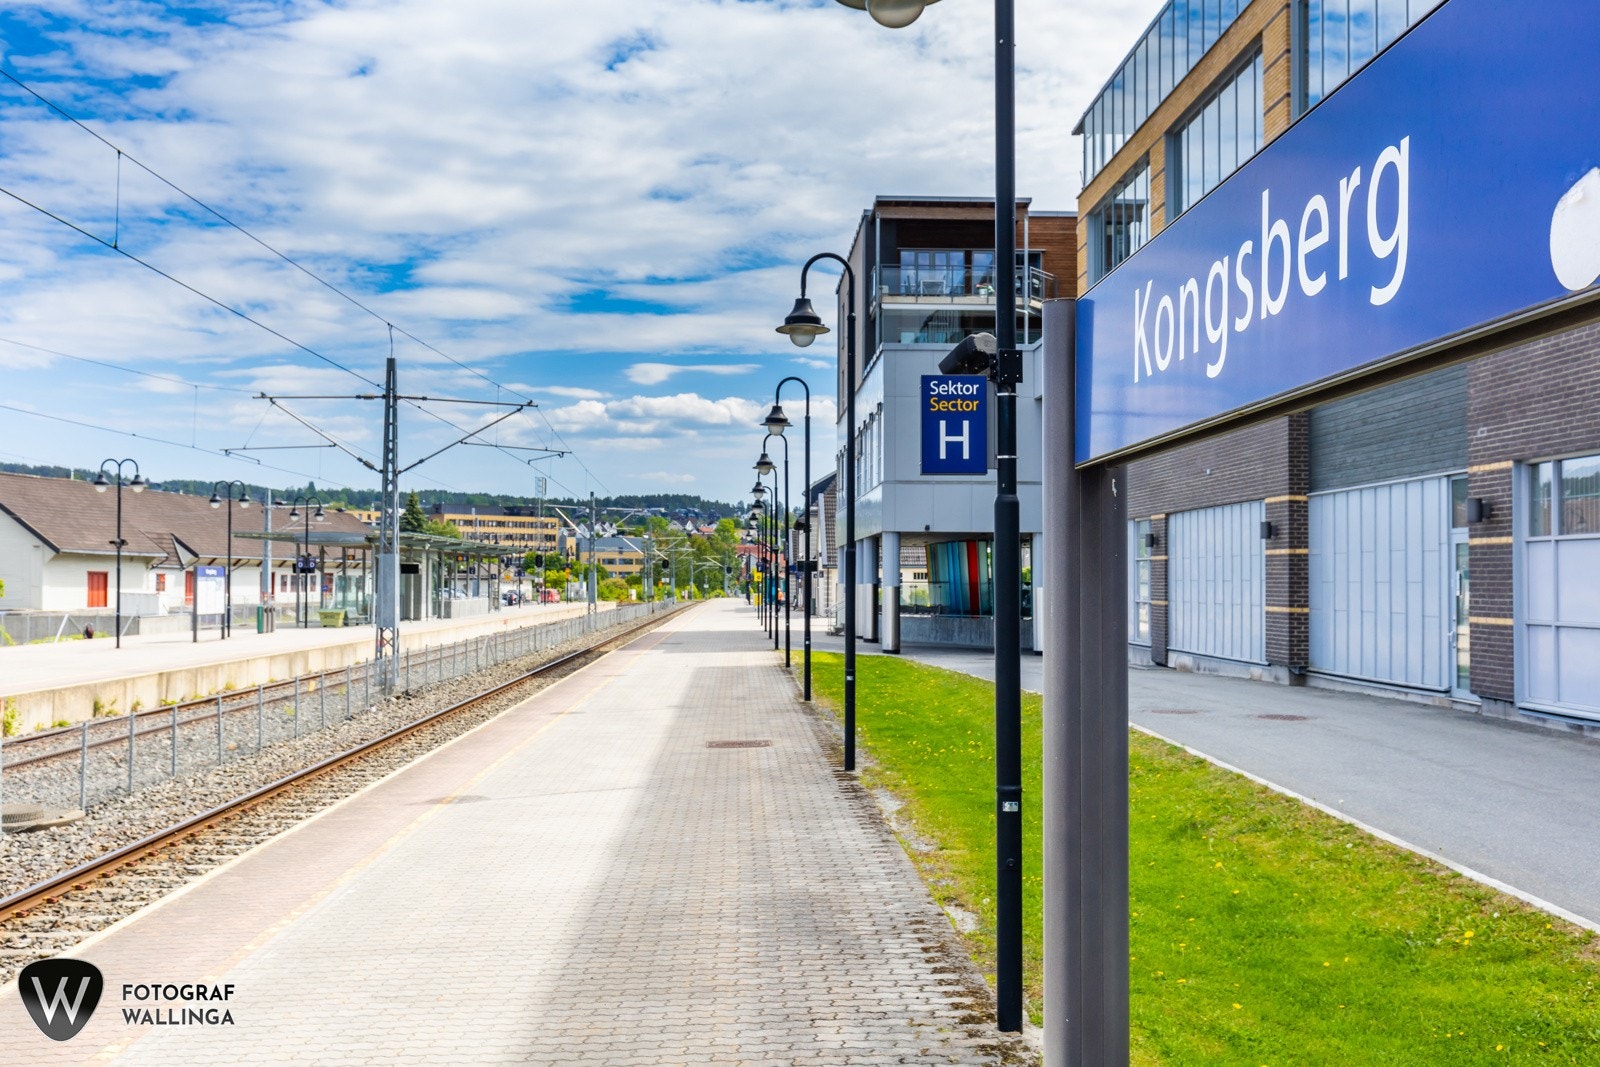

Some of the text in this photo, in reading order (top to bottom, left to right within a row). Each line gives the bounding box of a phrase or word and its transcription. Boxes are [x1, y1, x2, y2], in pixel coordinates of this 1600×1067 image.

[1133, 135, 1410, 383] Kongsberg
[930, 380, 979, 395] Sektor
[930, 397, 979, 411] Sector
[939, 420, 970, 460] H
